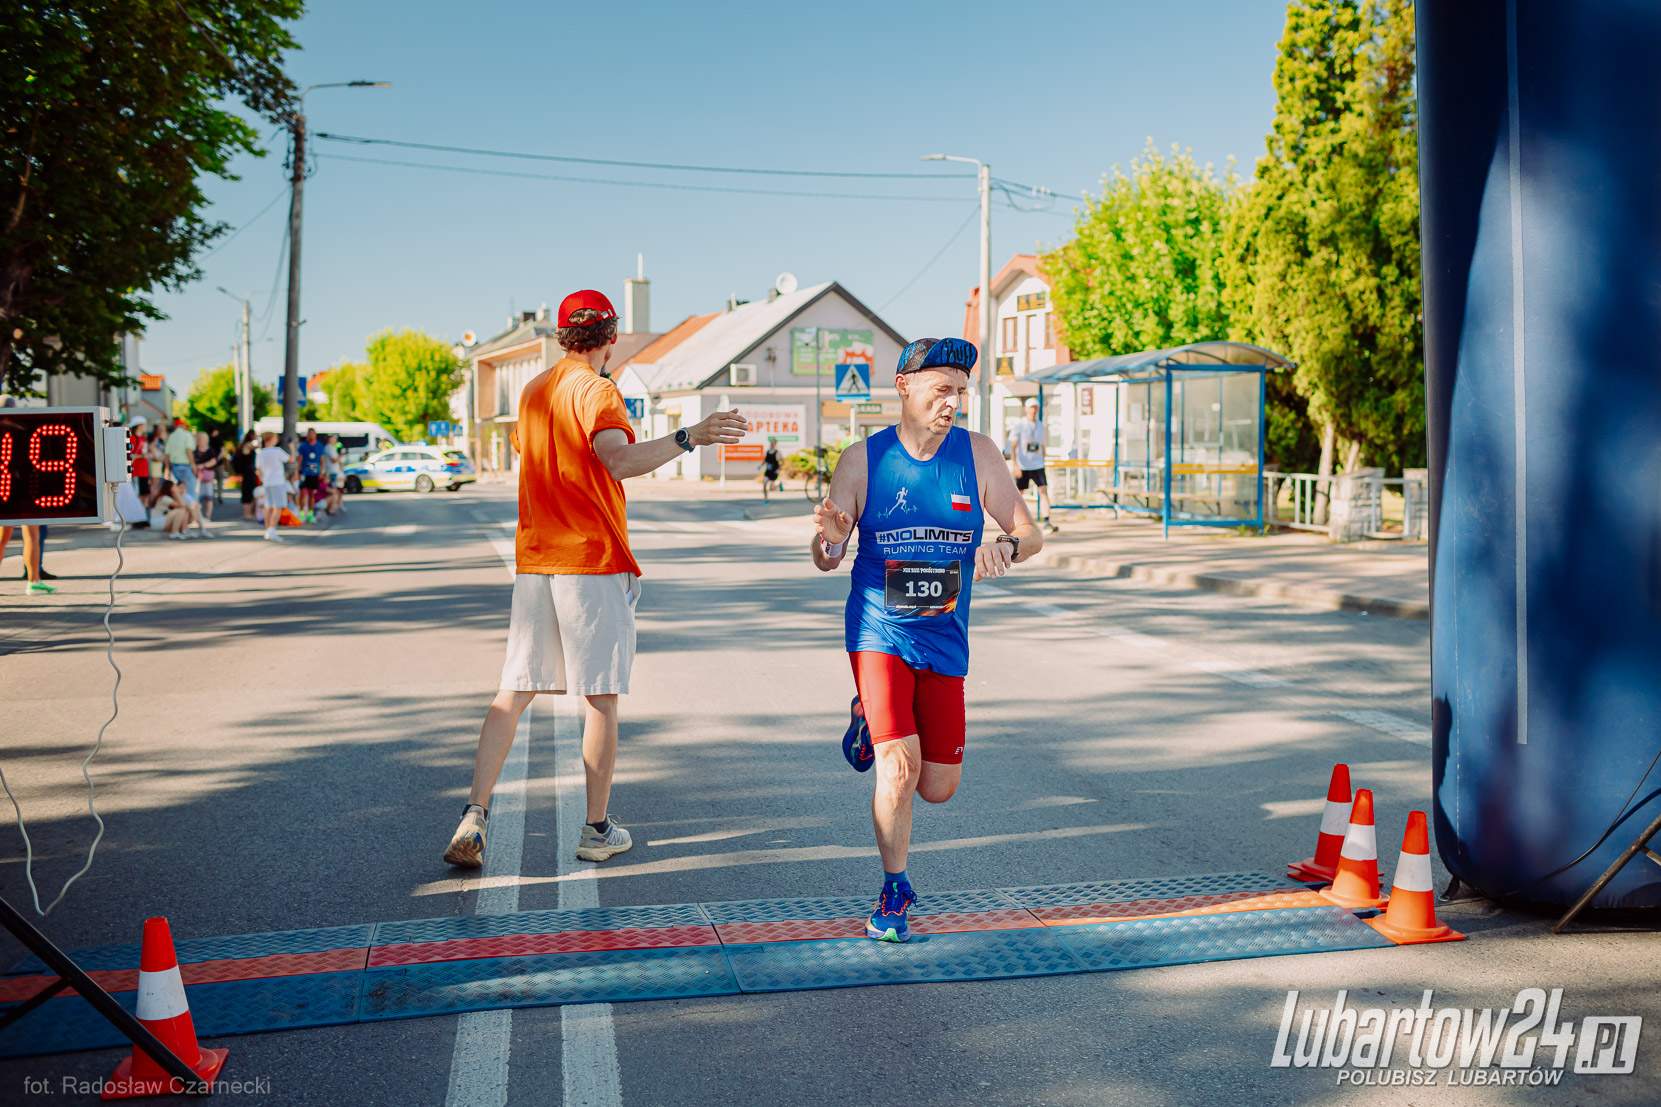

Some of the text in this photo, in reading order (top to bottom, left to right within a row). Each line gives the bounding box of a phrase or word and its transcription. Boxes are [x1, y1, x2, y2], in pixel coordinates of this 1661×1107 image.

[878, 527, 973, 543] #NOLIMITS
[883, 544, 968, 555] RUNNING TEAM
[905, 580, 943, 597] 130
